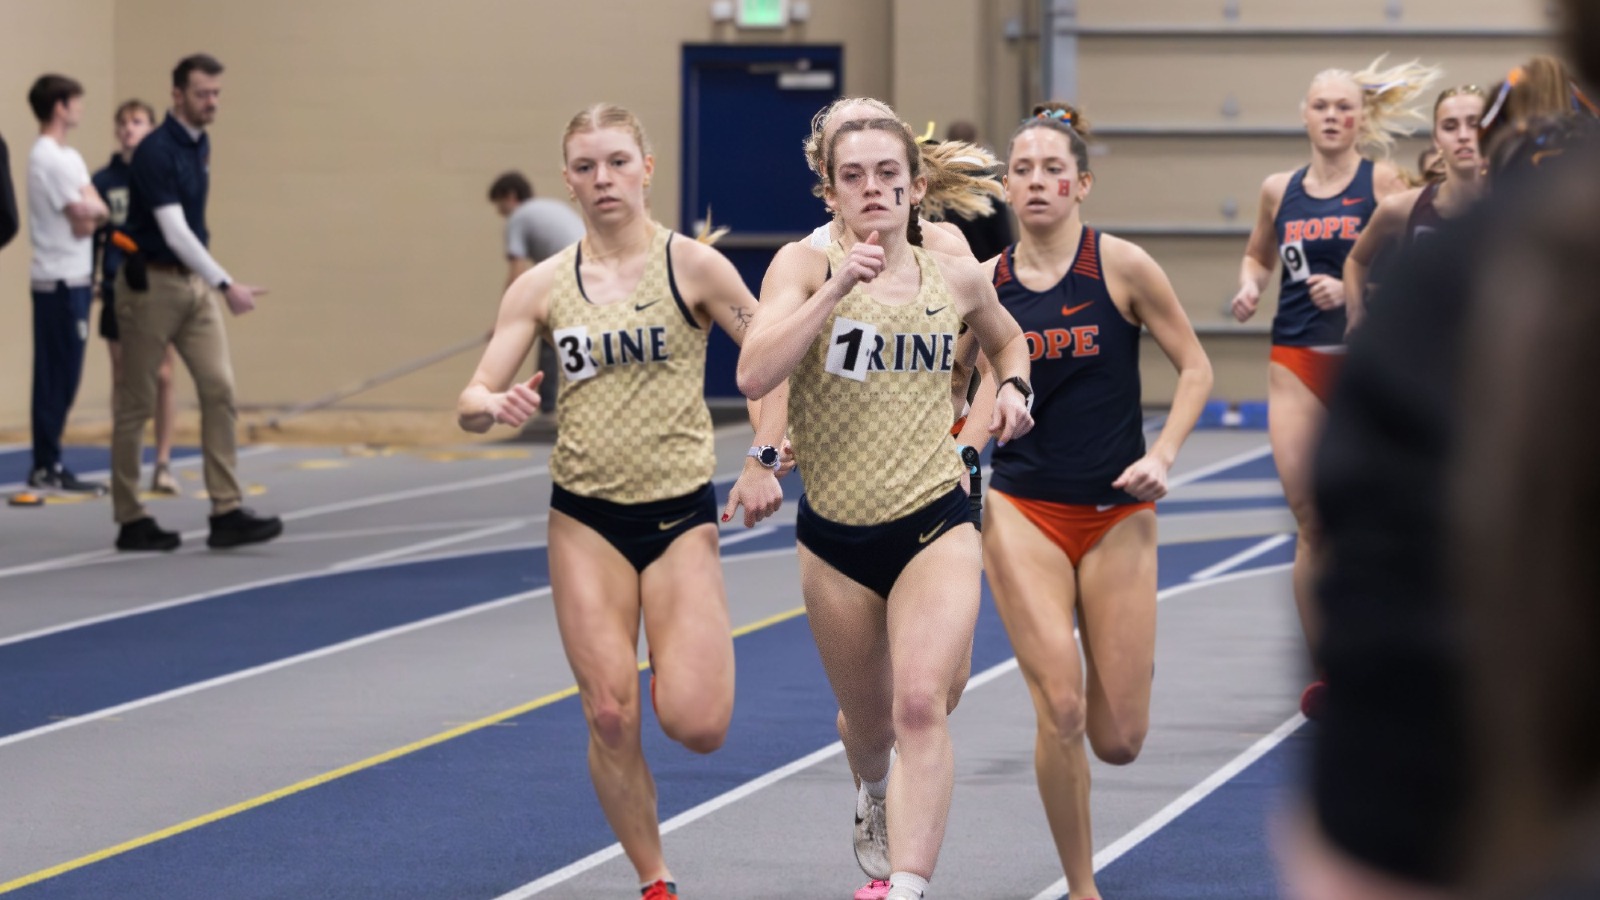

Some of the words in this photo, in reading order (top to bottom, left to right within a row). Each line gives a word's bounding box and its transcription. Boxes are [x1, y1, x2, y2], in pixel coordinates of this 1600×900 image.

[893, 187, 904, 206] T
[1284, 216, 1361, 243] HOPE
[1284, 245, 1303, 272] 9
[559, 335, 586, 373] 3
[835, 327, 864, 371] 1
[1024, 325, 1100, 361] OPE
